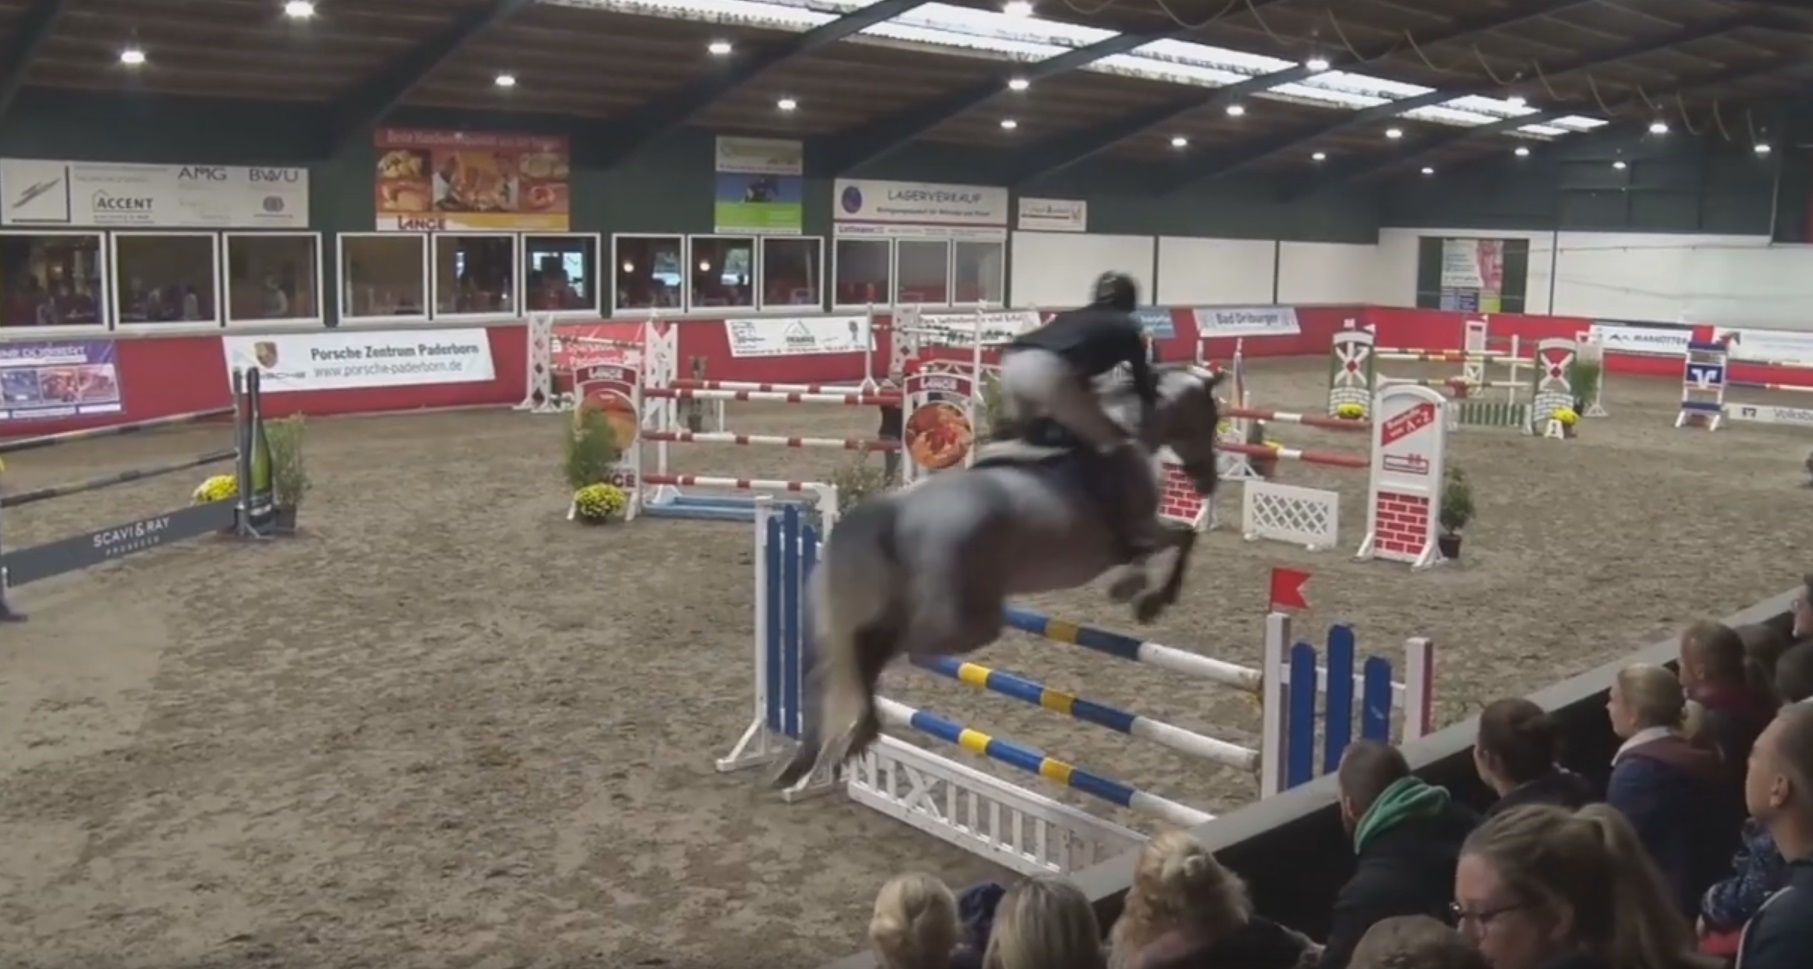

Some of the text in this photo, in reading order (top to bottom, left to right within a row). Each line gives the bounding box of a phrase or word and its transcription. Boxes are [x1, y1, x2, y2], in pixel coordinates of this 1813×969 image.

[178, 166, 227, 181] AMG
[249, 168, 299, 183] BWU
[97, 197, 153, 209] ACCENT
[887, 189, 982, 204] LAGERVERKAUF
[1215, 312, 1278, 326] Bad Driburger
[310, 343, 479, 361] Porsche Zentrum Paderborn
[314, 360, 463, 378] www.porsche-paderborn.de
